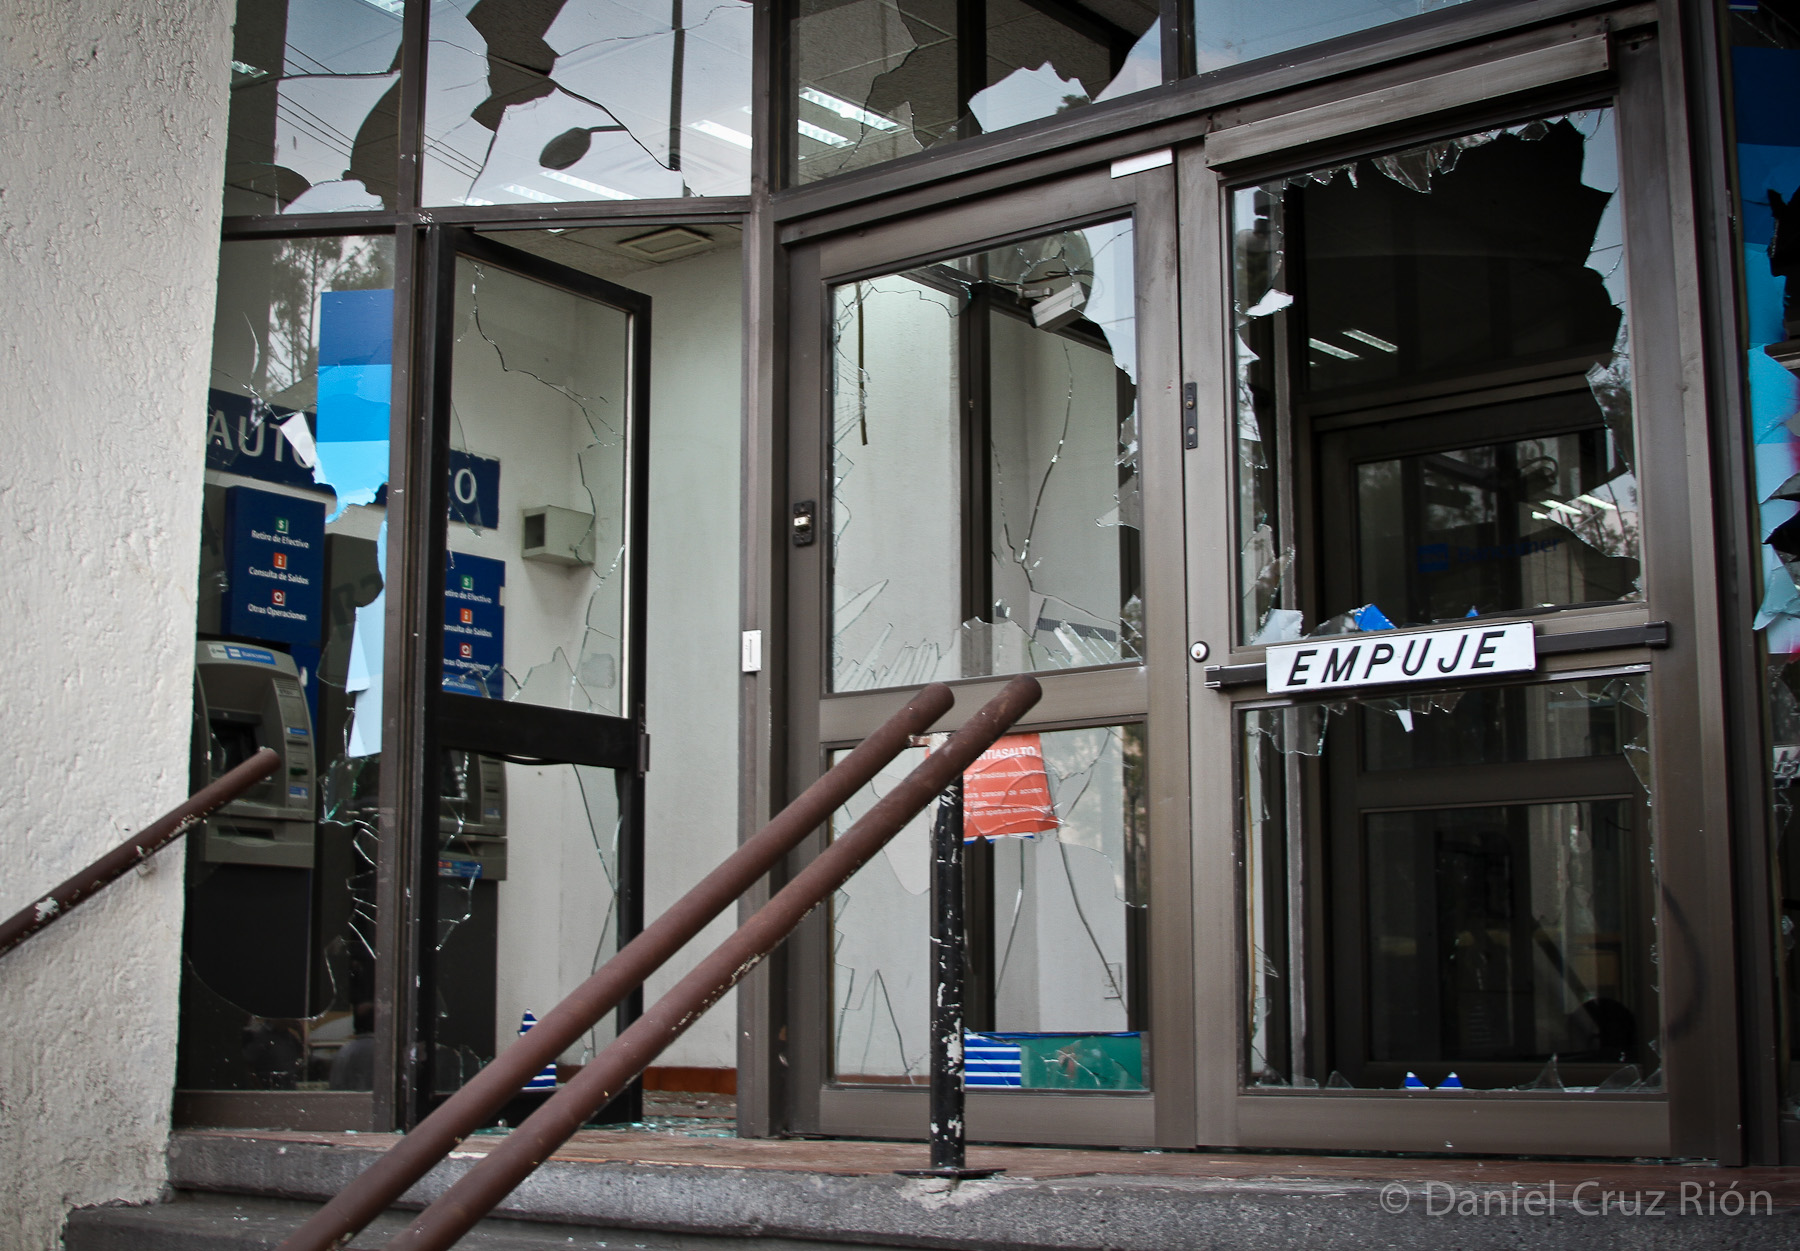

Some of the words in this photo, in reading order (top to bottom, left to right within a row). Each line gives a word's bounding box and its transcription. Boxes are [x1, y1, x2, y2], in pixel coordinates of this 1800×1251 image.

[454, 467, 478, 504] O
[251, 529, 272, 542] Retiro
[272, 534, 281, 544] de
[281, 536, 310, 549] Efectivo
[248, 566, 278, 580] Consulta
[278, 571, 287, 582] de
[288, 573, 309, 585] Saldos
[444, 589, 459, 598] etiro
[459, 591, 467, 600] de
[468, 592, 492, 604] Efectivo
[247, 603, 267, 615] Otras
[267, 606, 307, 621] Operaciones
[465, 626, 473, 635] de
[473, 627, 492, 638] Saldos
[1287, 630, 1506, 686] EMPUJE
[976, 746, 1035, 760] NTIASALTO
